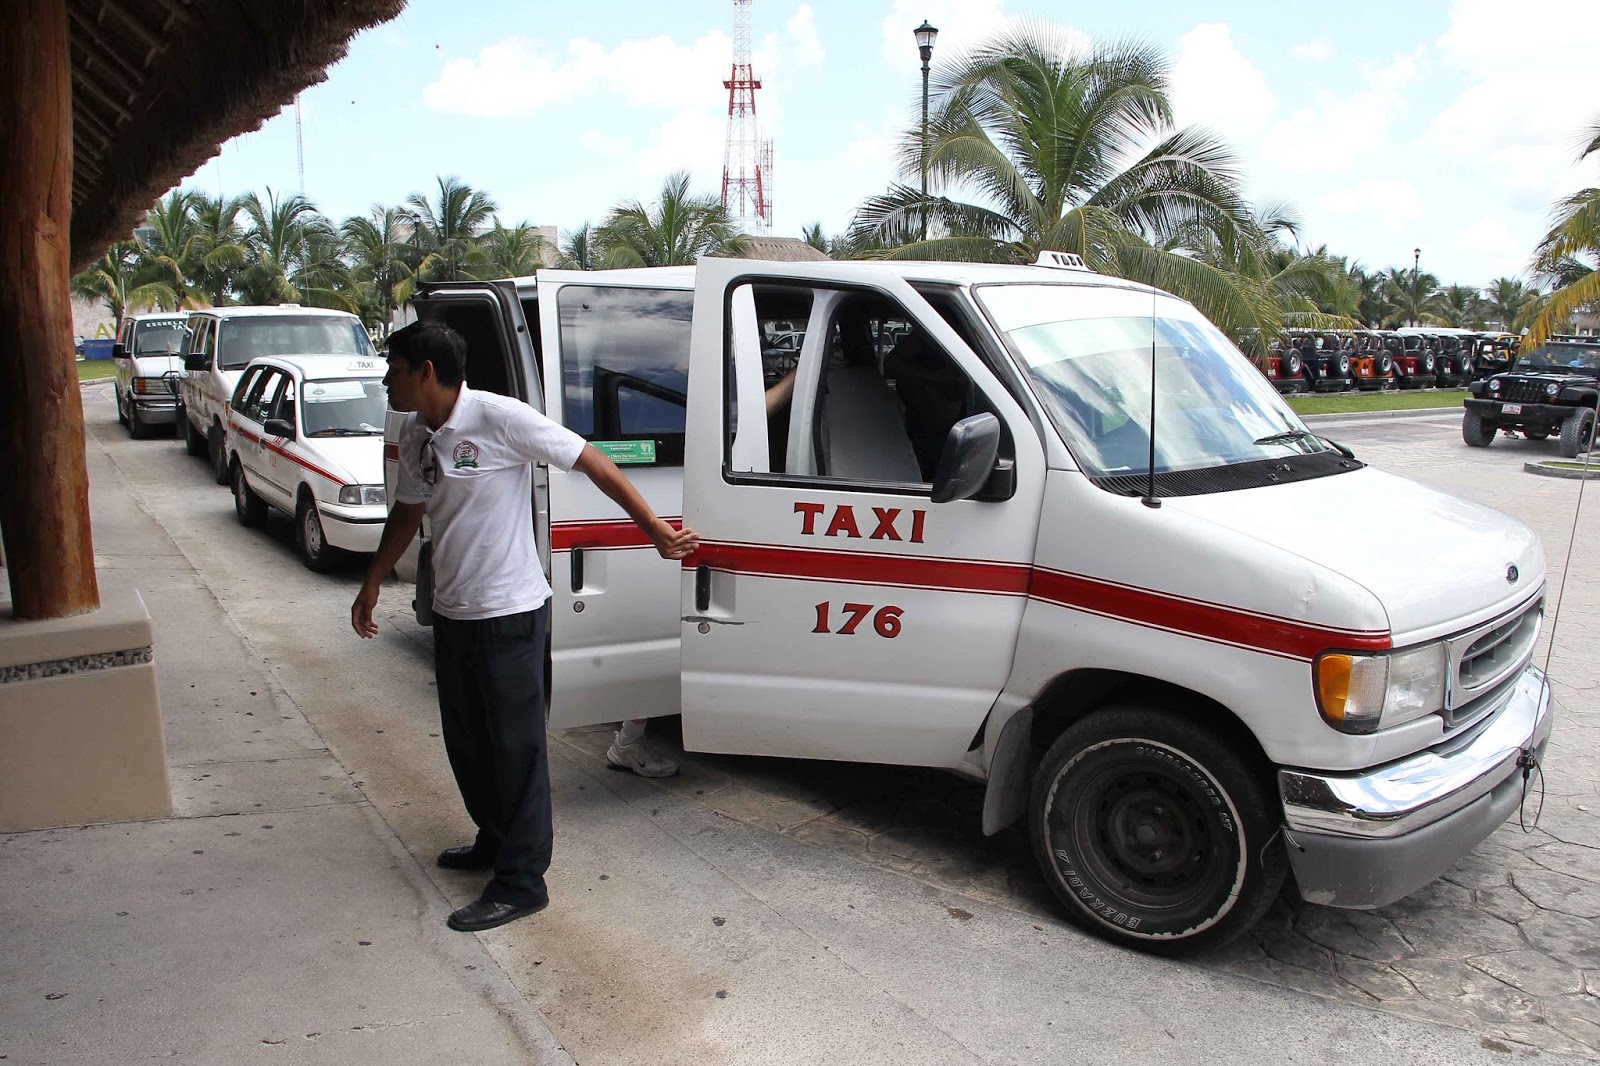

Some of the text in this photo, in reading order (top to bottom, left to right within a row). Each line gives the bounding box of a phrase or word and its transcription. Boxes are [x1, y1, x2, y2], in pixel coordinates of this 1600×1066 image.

[1050, 253, 1084, 267] TAXI
[146, 320, 184, 328] ESCUELA
[356, 361, 374, 369] TAXI
[794, 502, 927, 544] TAXI
[811, 601, 905, 638] 176
[1135, 746, 1221, 805] OVERLANDER
[1063, 870, 1142, 929] EUZKADI
